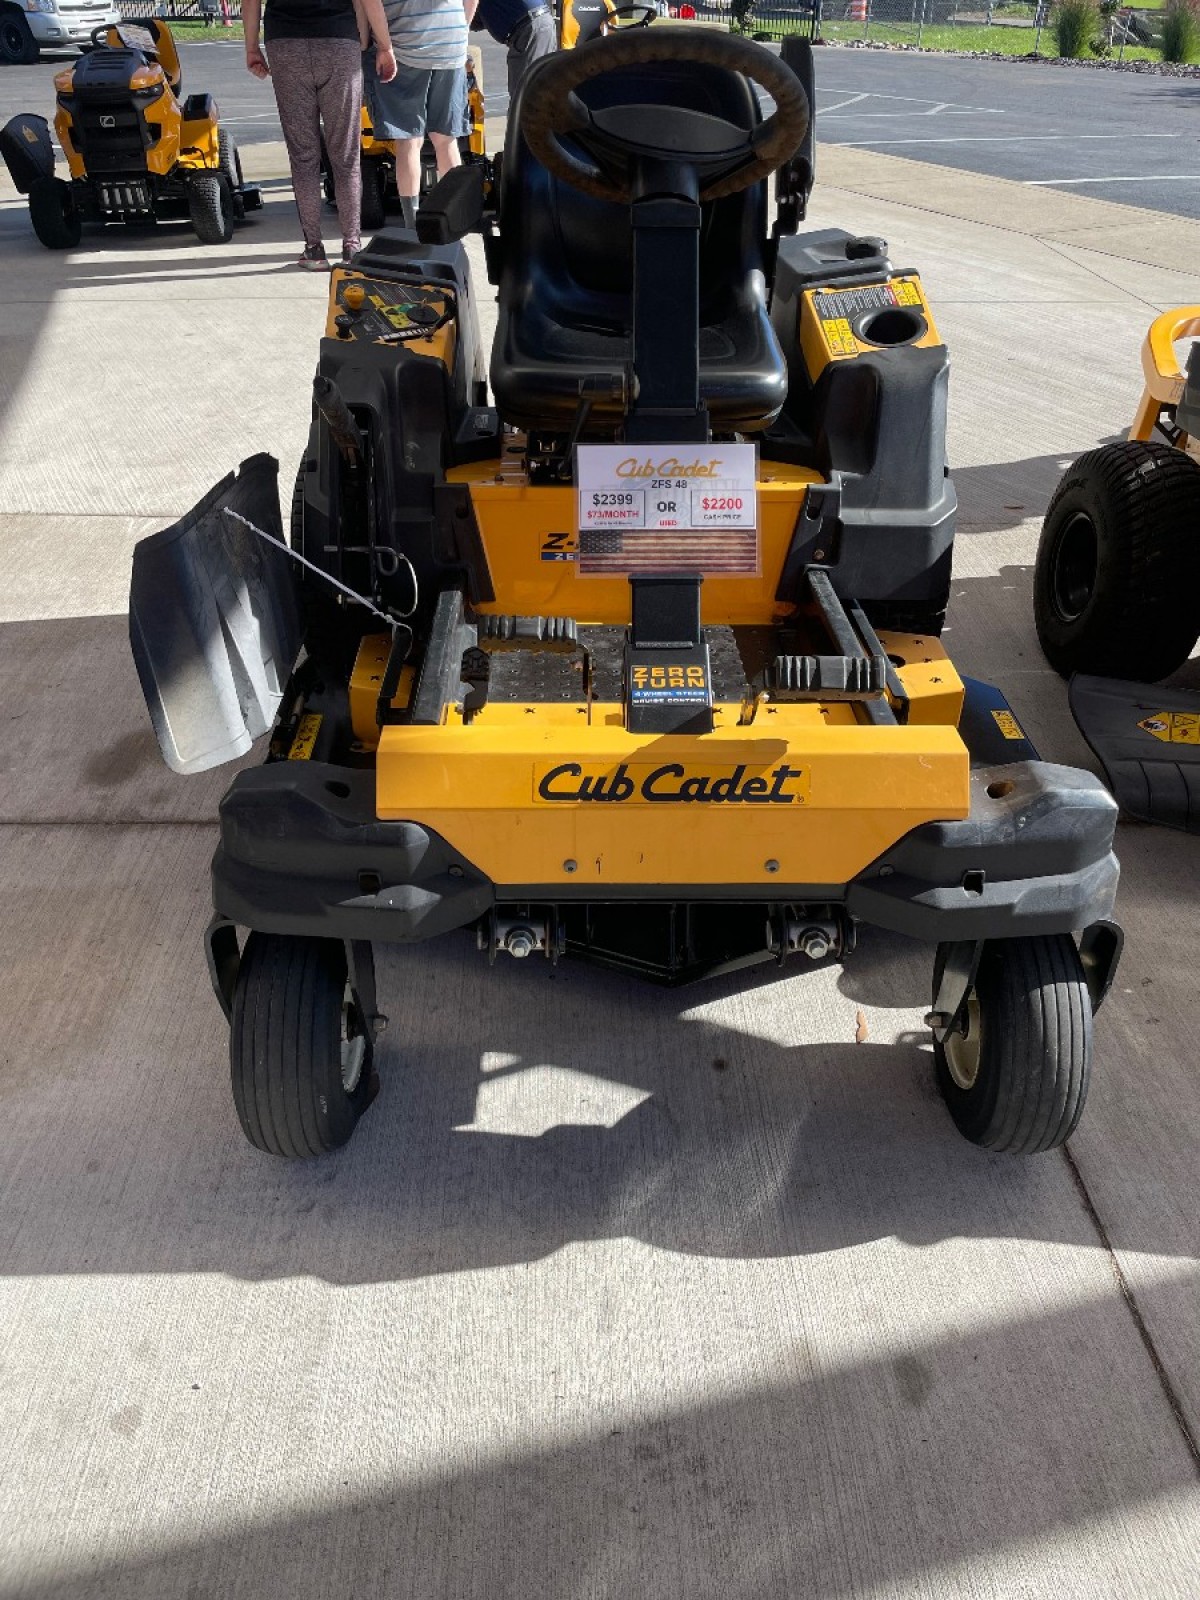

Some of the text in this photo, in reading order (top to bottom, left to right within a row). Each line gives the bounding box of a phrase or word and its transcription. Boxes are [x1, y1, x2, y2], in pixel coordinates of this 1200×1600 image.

[615, 457, 723, 478] Cub Cadet
[651, 479, 688, 489] ZFS 48
[592, 493, 633, 507] $2399
[702, 497, 743, 511] $2200
[656, 501, 677, 513] OR
[587, 510, 640, 519] $73/MONTH
[634, 667, 704, 678] ZERO
[633, 678, 705, 689] TURN
[538, 763, 803, 803] Cub Cadet
